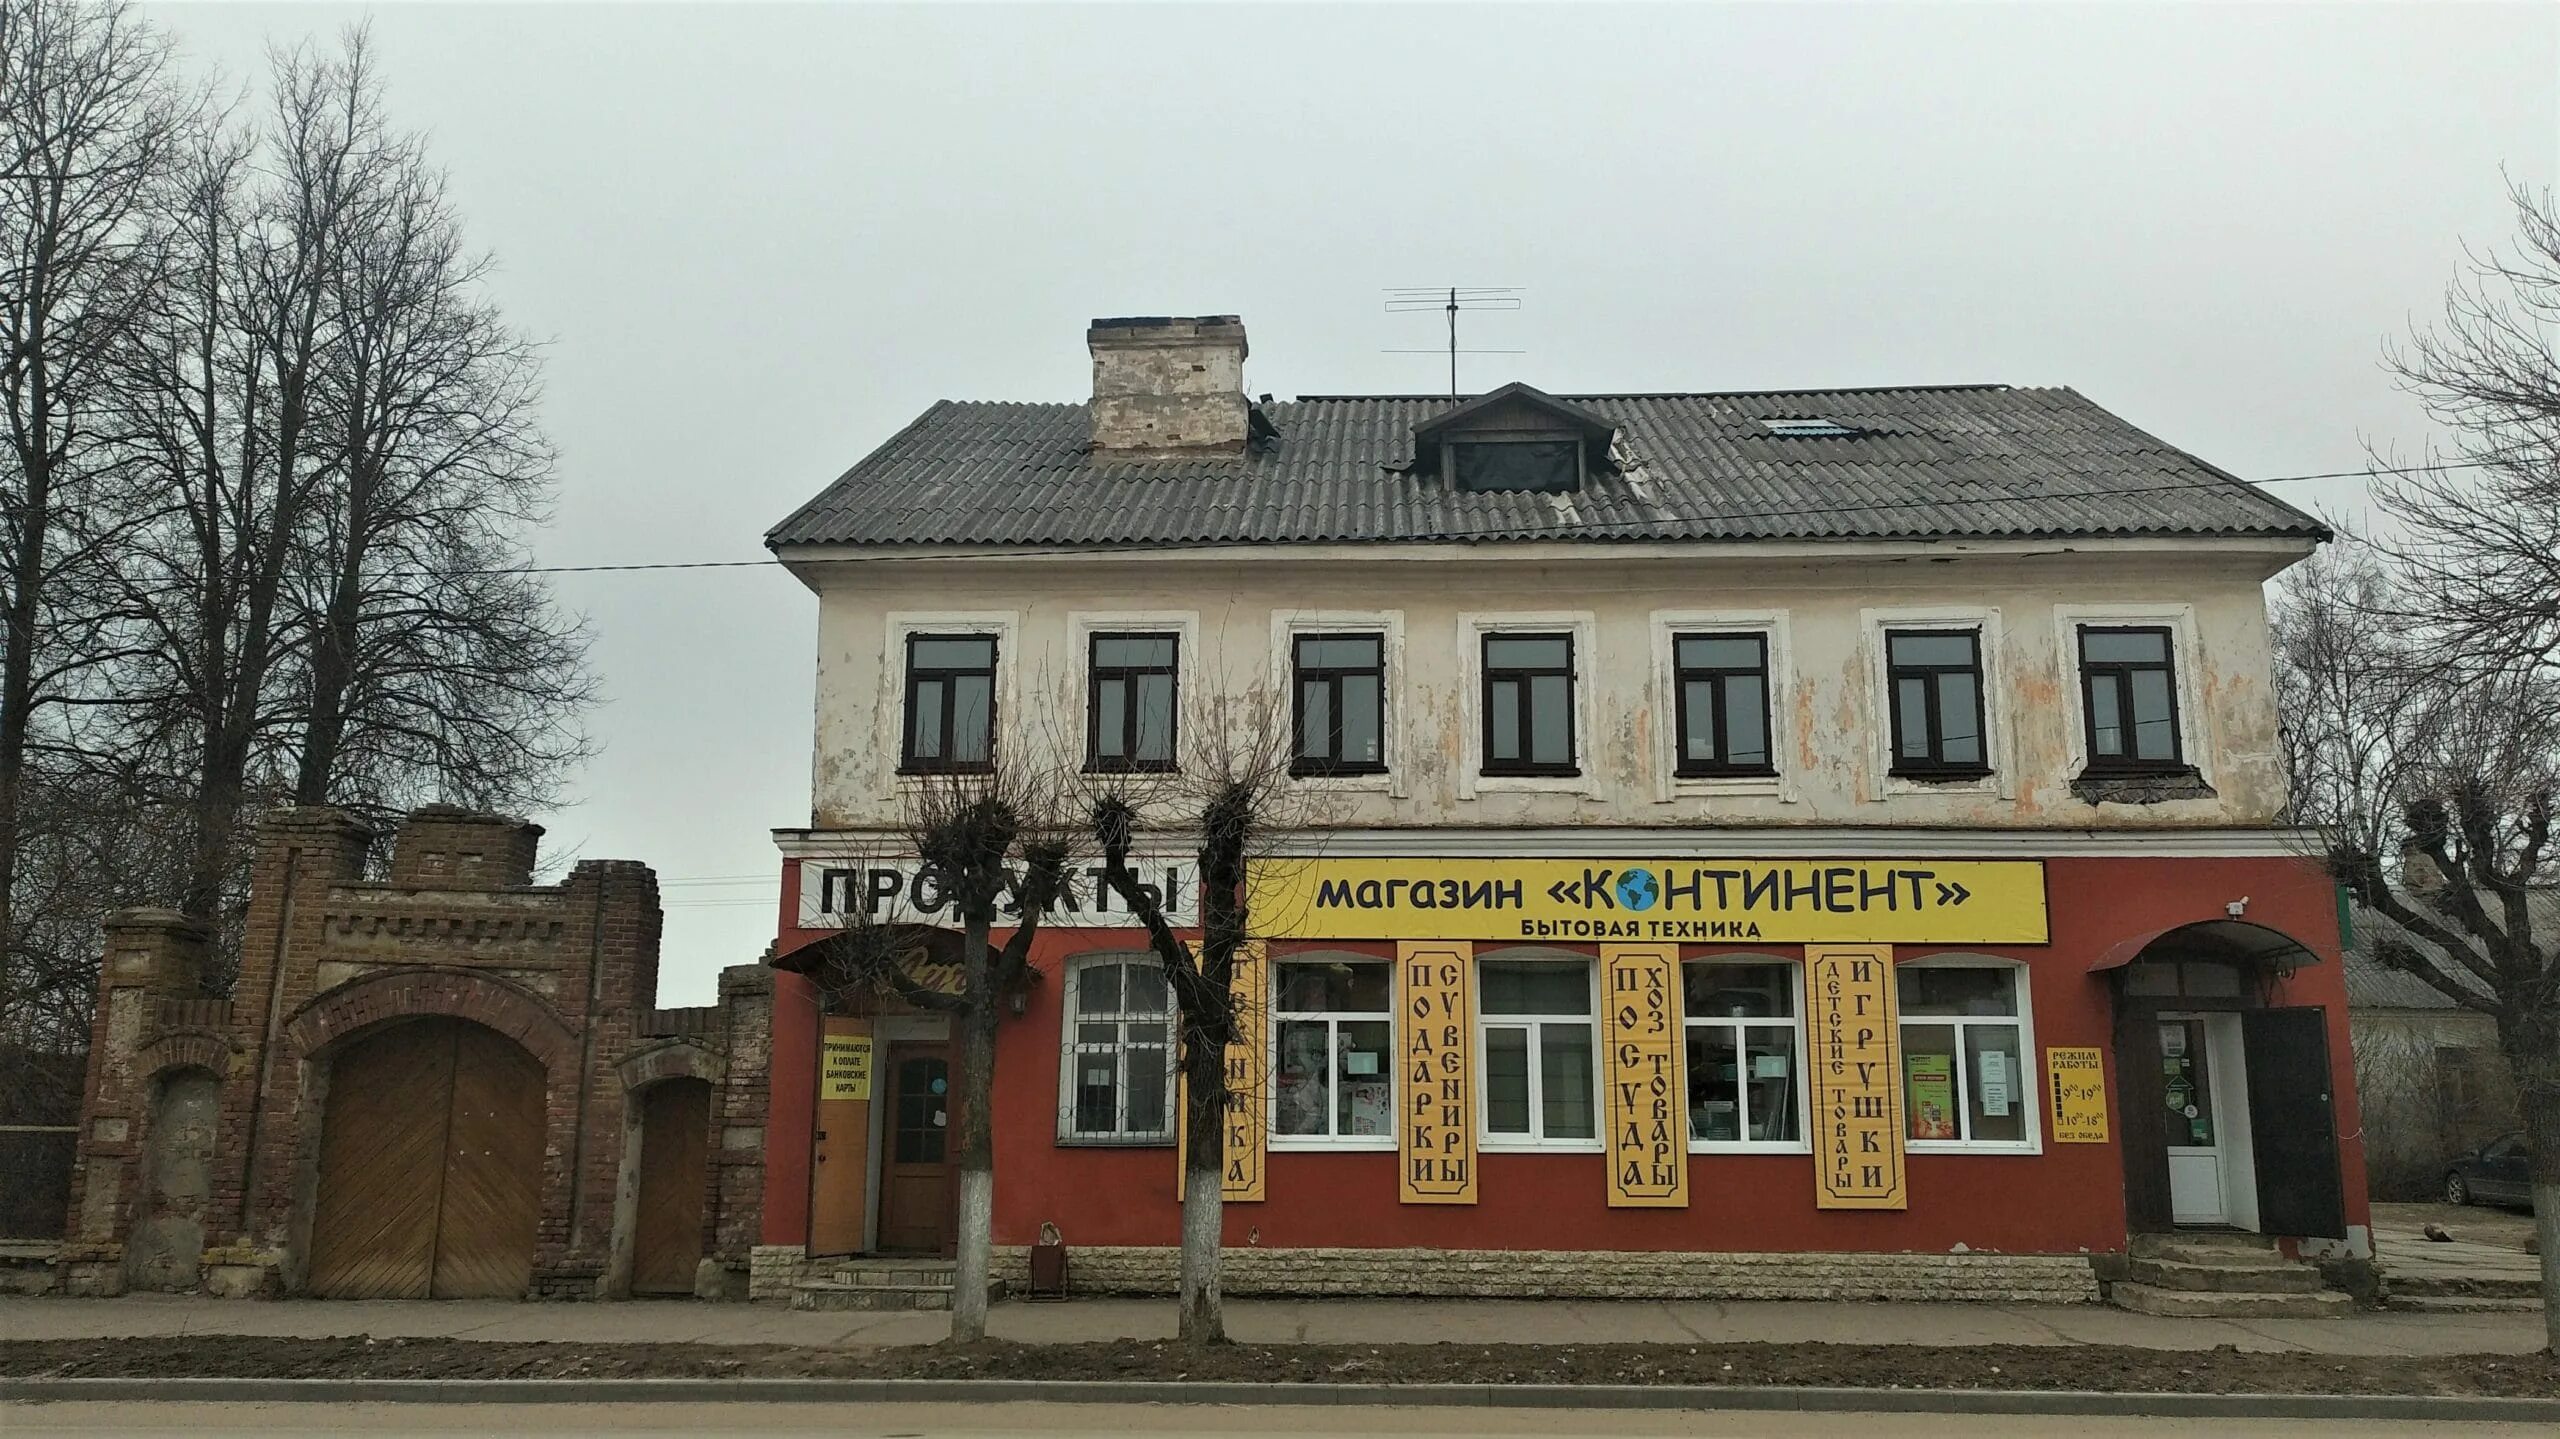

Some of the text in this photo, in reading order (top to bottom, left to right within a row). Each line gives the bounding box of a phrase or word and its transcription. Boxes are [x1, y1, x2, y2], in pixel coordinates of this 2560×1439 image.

[1316, 879, 1522, 909] магазин
[1521, 919, 1762, 938] БЫТОВАЯ ТЕХНИКА
[839, 1057, 862, 1066] ОПЛАТЕ
[2052, 1051, 2097, 1060] РЕЖИМ
[2052, 1060, 2098, 1069] РАБОТЫ
[825, 1069, 867, 1080] БАНКОВСКИЕ
[1411, 964, 1434, 1182] ПОДАРКИ
[1440, 964, 1465, 1182] СУВЕНИРЫ
[1615, 967, 1645, 1186] ПОСУДА
[1644, 967, 1674, 1186] ХОЗ ТОВАРЫ
[1827, 961, 1852, 1188] ДЕТСКИЕ ТОВАРЫ
[1851, 960, 1884, 1188] ИГРУШКИ
[836, 1083, 857, 1093] КАРТЫ
[2059, 1131, 2076, 1139] БЕЗ
